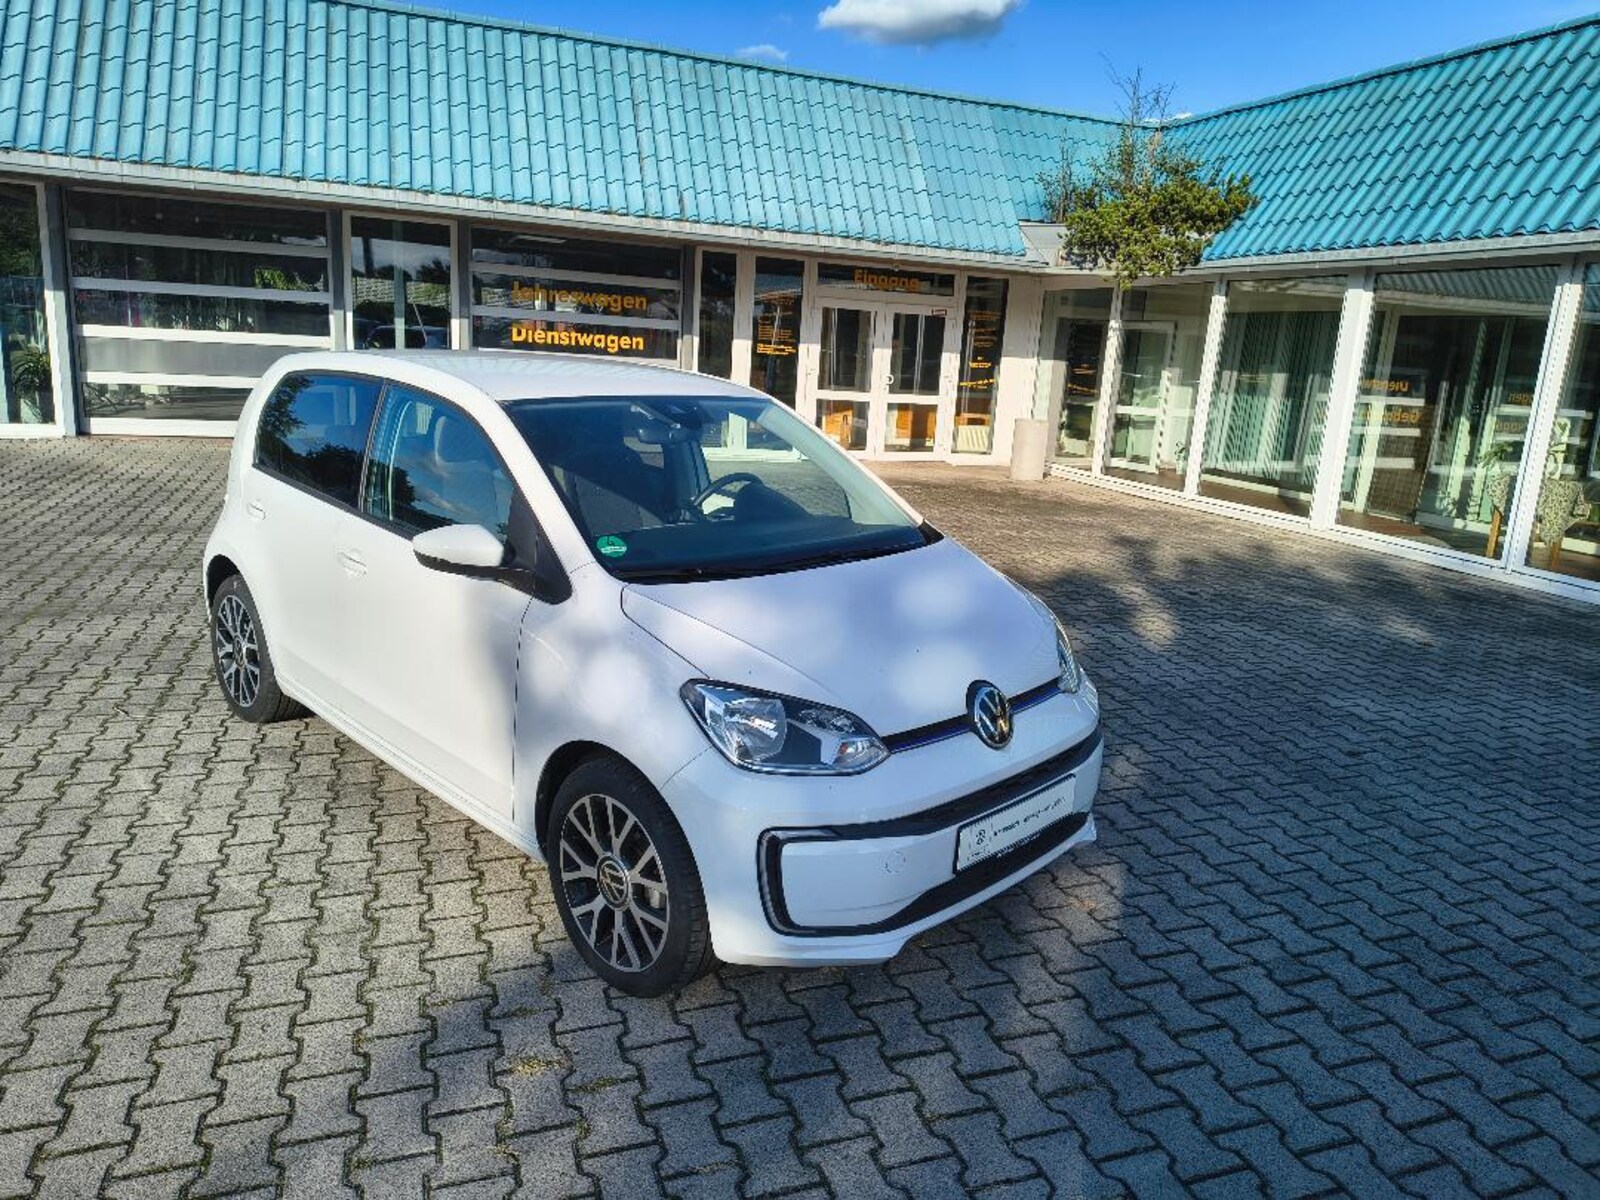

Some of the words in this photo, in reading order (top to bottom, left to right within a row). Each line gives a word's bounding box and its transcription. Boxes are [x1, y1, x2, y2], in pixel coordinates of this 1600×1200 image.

[854, 268, 920, 293] Eingang
[511, 280, 648, 312] Jahreswagen
[511, 324, 645, 353] Dienstwagen
